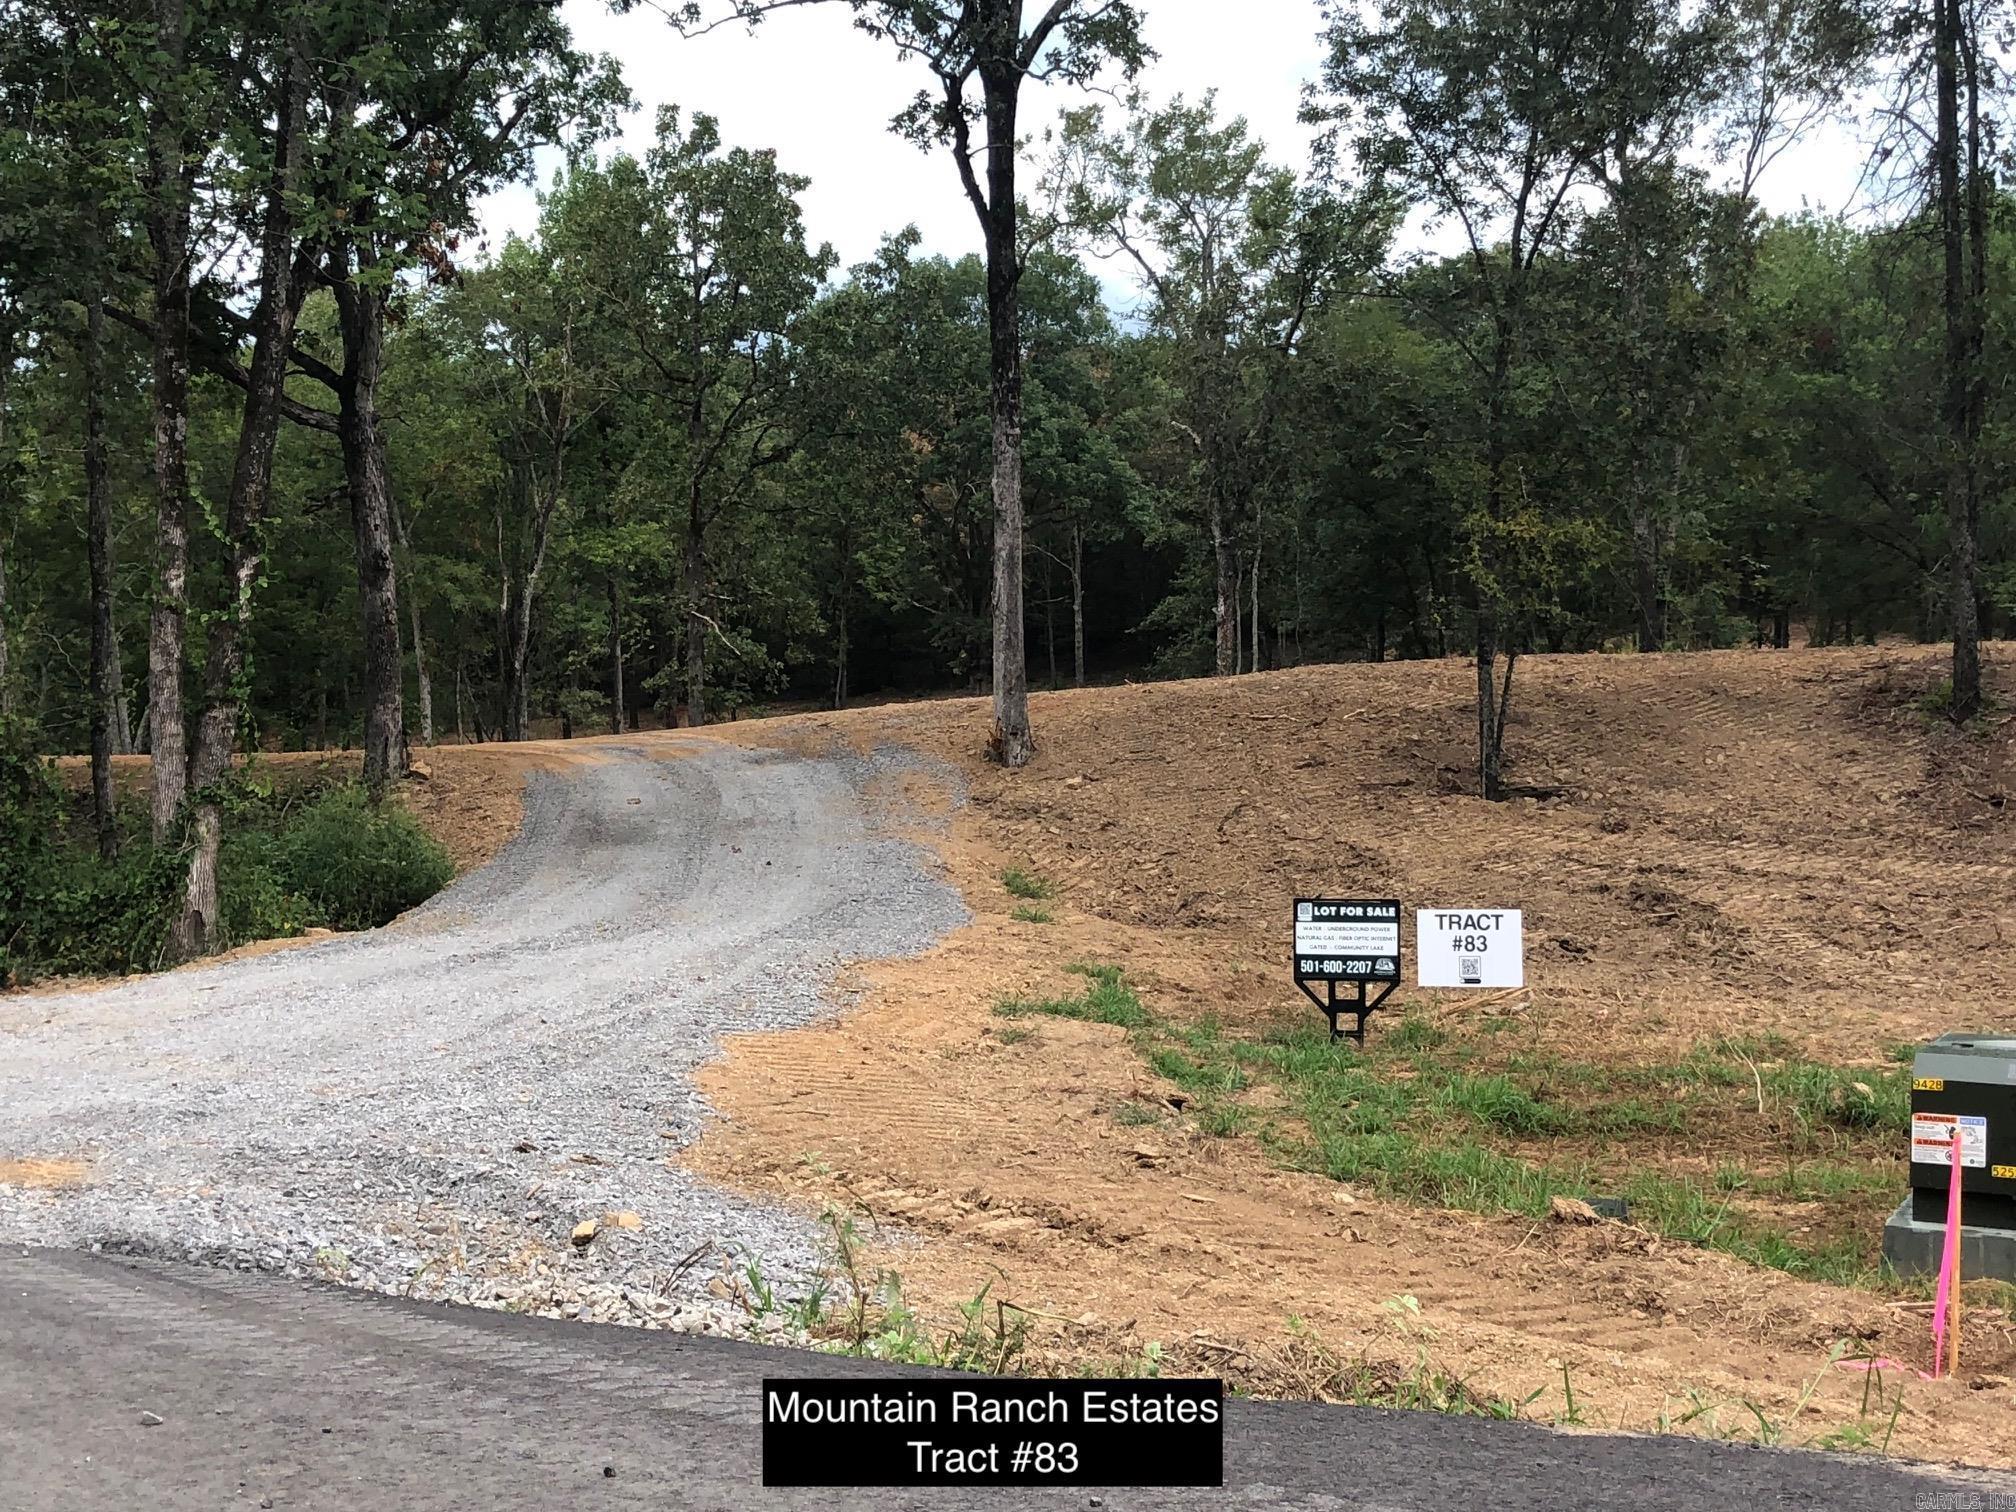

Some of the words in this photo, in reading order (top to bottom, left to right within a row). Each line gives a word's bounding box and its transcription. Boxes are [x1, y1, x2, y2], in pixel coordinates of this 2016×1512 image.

[1314, 906, 1337, 916] LOT
[1340, 906, 1363, 917] FOR
[1366, 907, 1396, 917] SALE
[1434, 914, 1504, 931] TRACT
[1452, 935, 1488, 952] #83
[1300, 960, 1372, 974] 501-600-2207
[1913, 1079, 1942, 1089] 9428
[1923, 1139, 1953, 1147] WARNIN
[1993, 1166, 2016, 1178] 525
